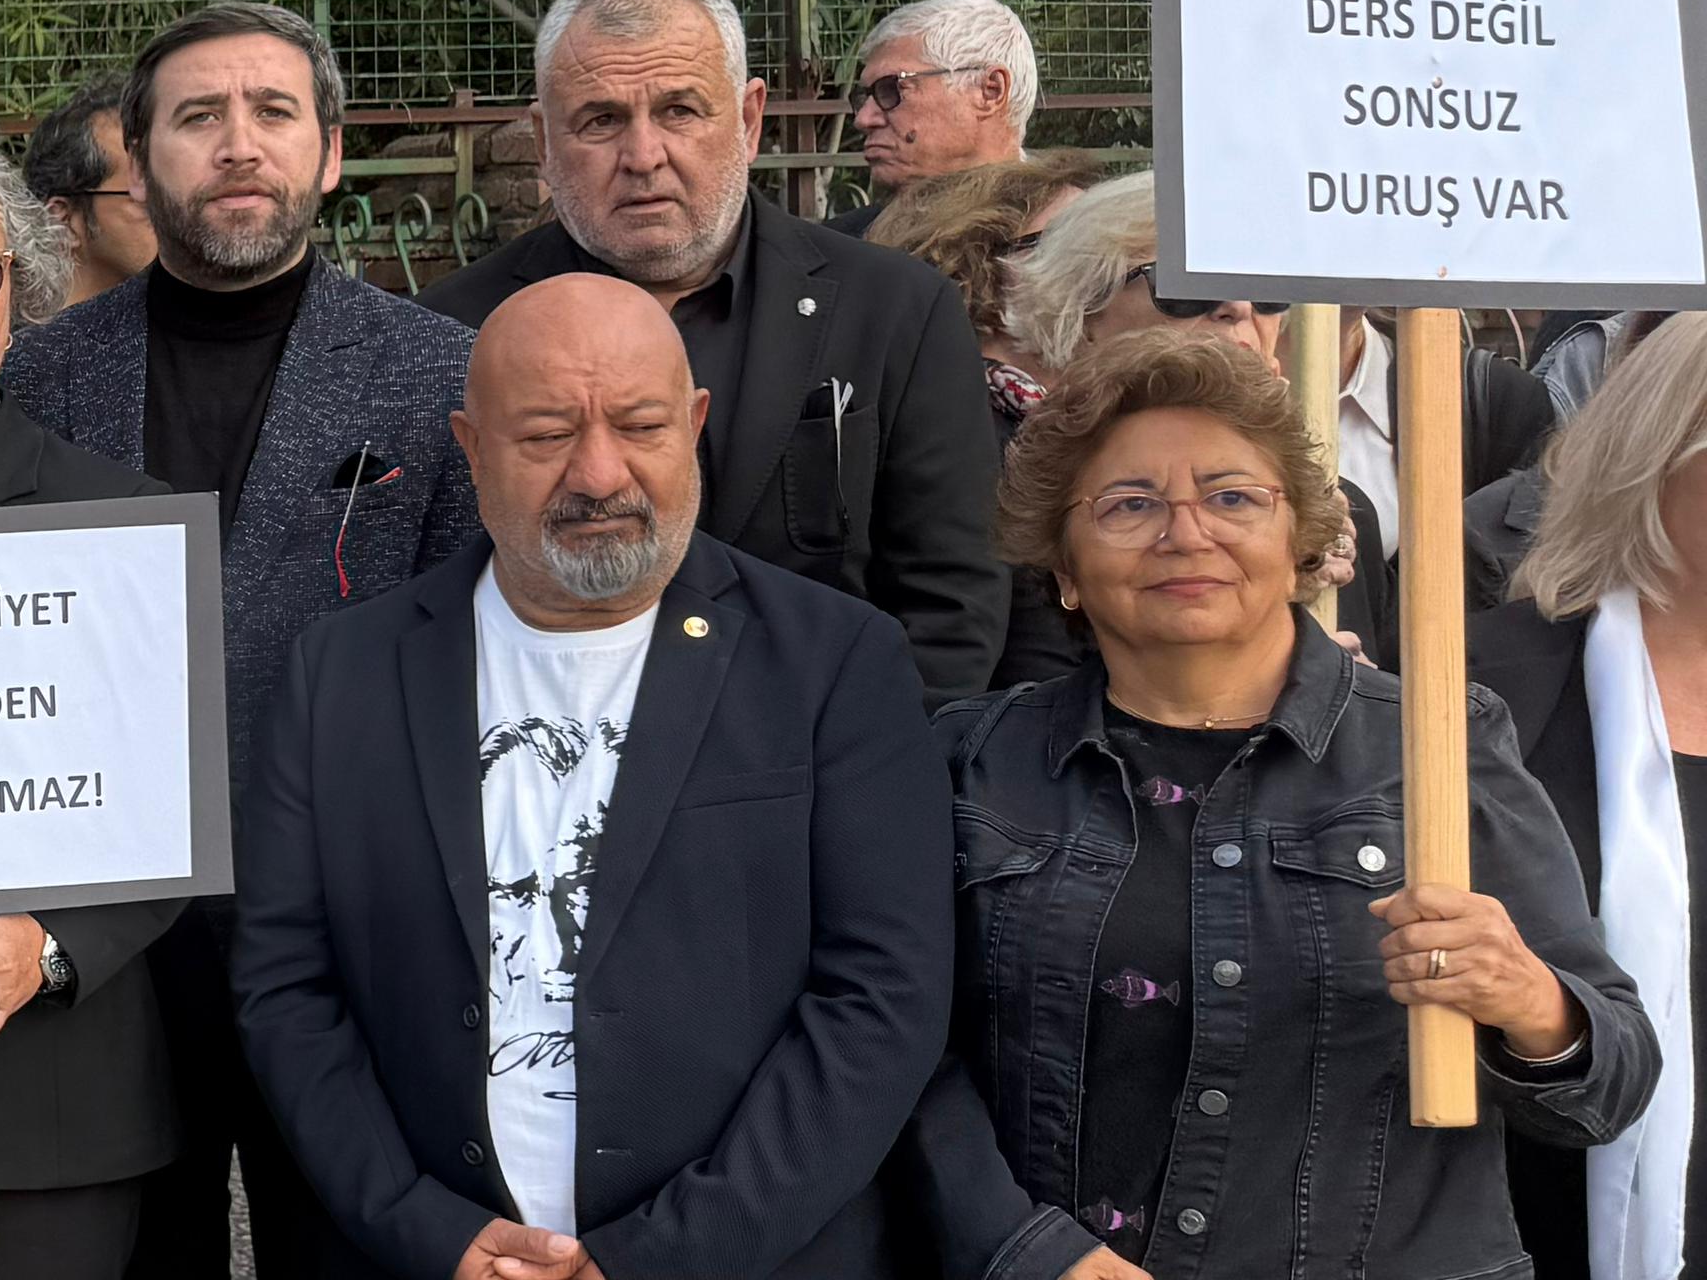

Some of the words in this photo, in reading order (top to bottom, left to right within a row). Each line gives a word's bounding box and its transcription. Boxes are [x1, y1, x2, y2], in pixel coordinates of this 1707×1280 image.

[1344, 84, 1521, 132] SONSUZ
[1308, 171, 1460, 228] DURUŞ
[1473, 177, 1568, 220] VAR
